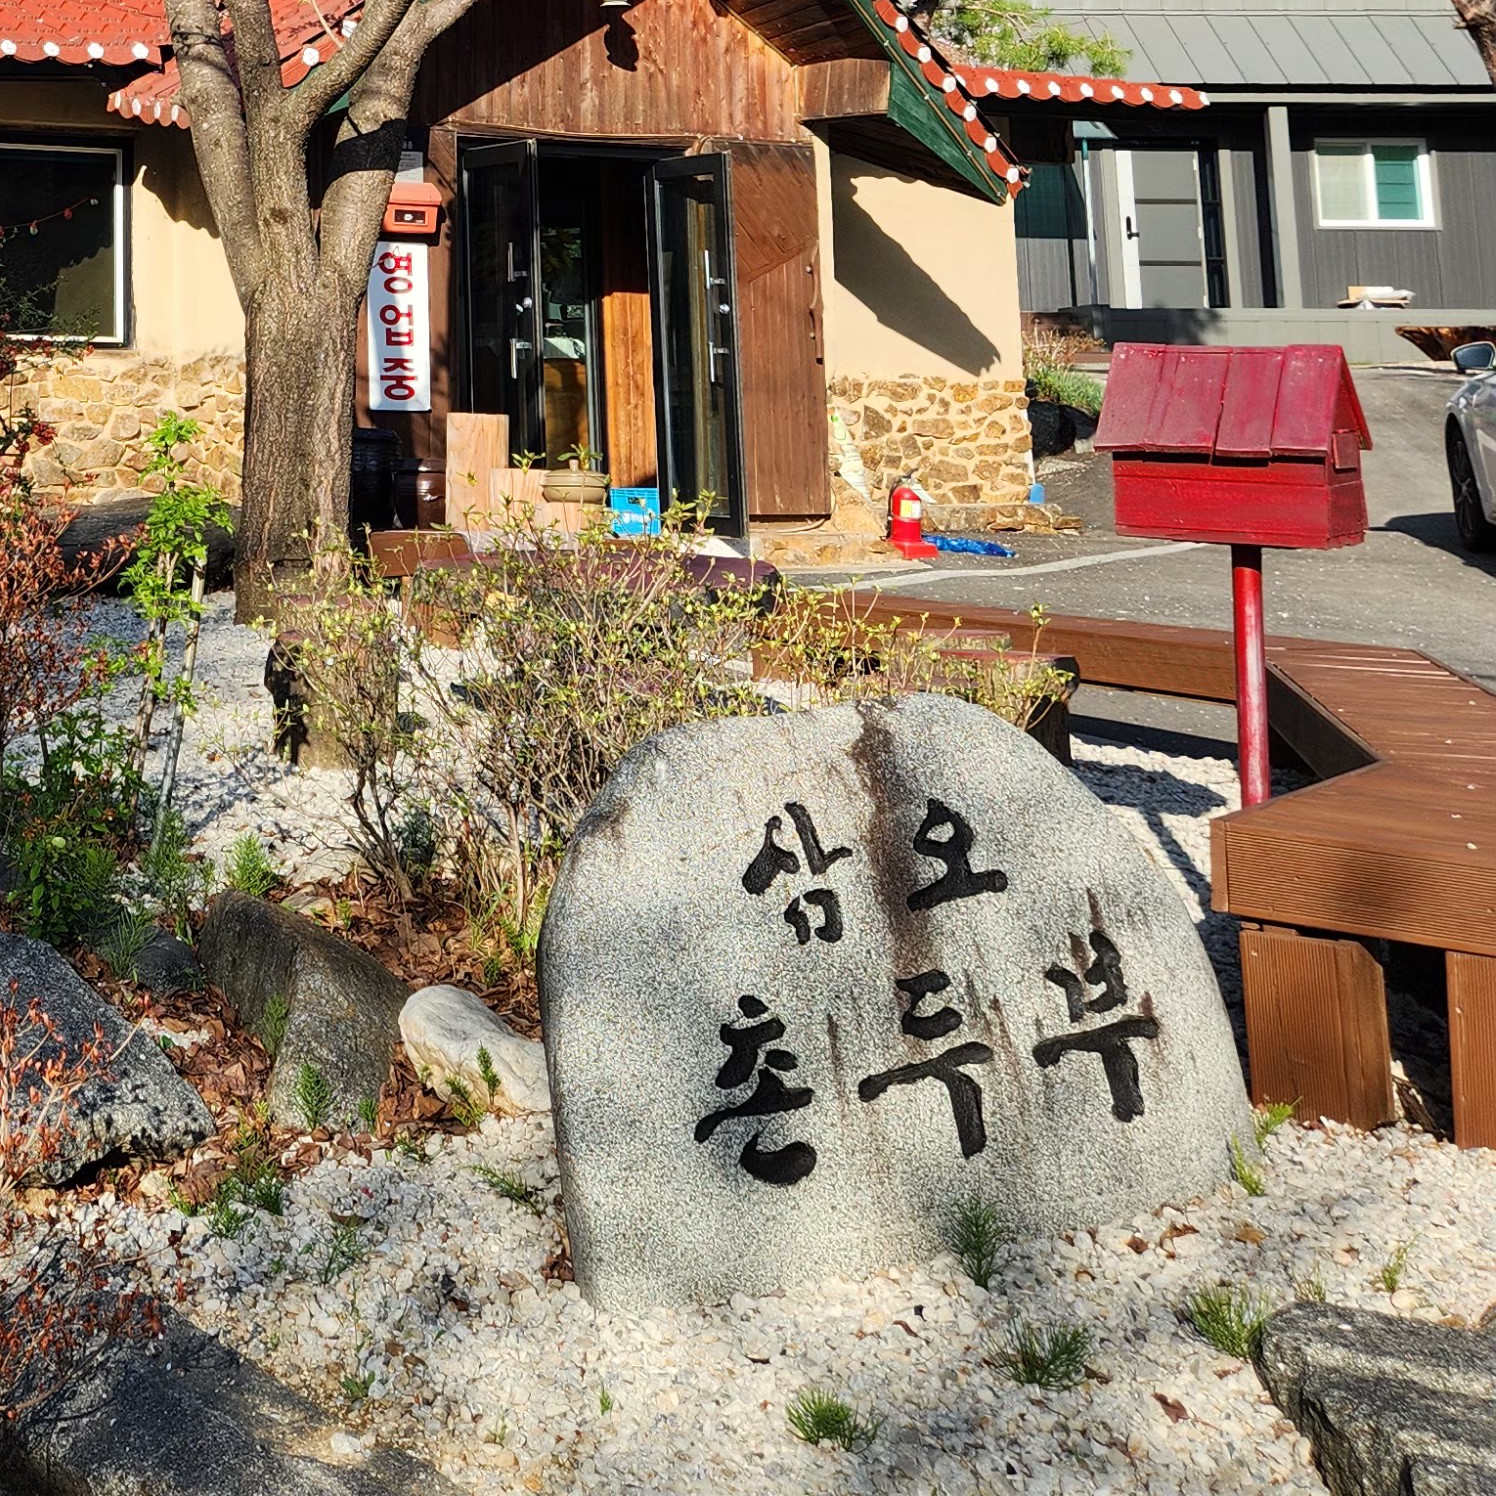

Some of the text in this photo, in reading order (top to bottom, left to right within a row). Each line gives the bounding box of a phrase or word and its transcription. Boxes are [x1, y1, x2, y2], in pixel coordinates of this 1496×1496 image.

[378, 251, 418, 402] 영업중
[741, 798, 1008, 944] 삼오
[694, 929, 1161, 1185] 촌두부
